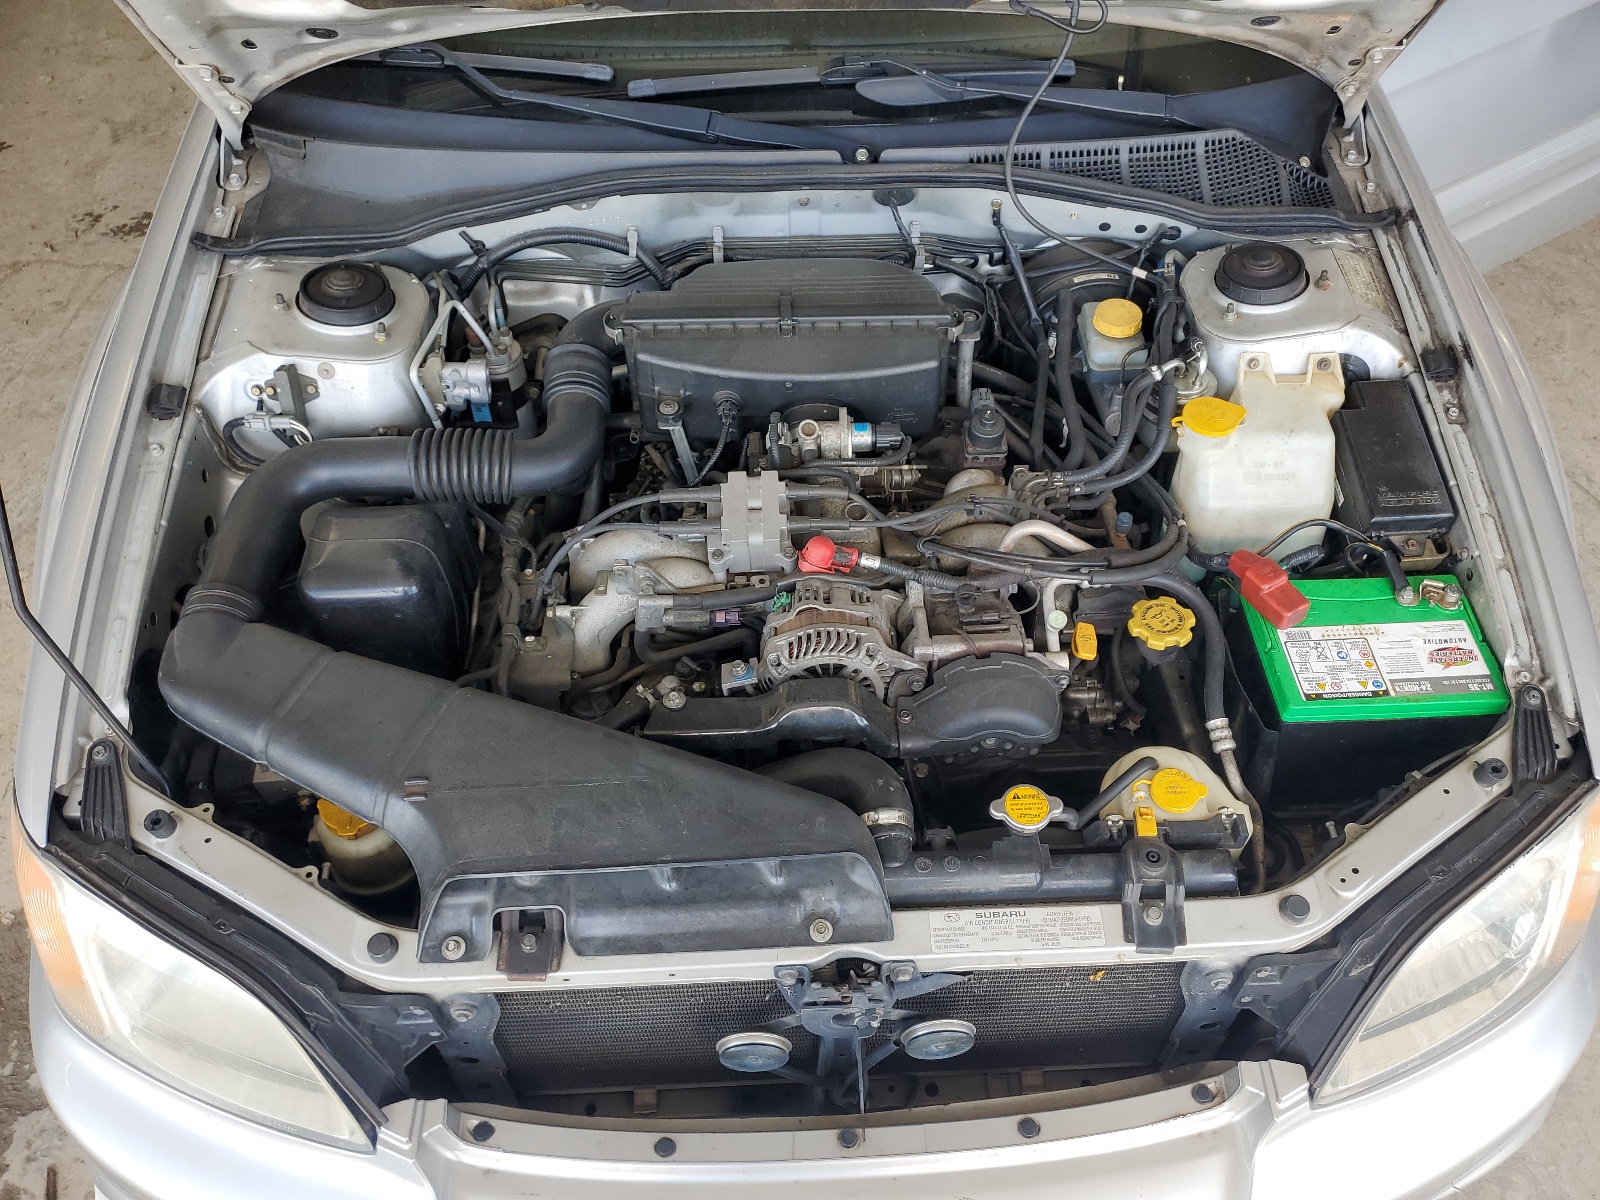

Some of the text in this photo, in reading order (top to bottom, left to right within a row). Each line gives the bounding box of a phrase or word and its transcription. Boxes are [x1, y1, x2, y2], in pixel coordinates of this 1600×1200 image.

[1428, 649, 1474, 657] BATTERIES
[1427, 655, 1478, 664] INTERSTATE
[975, 910, 1026, 919] SUBARU
